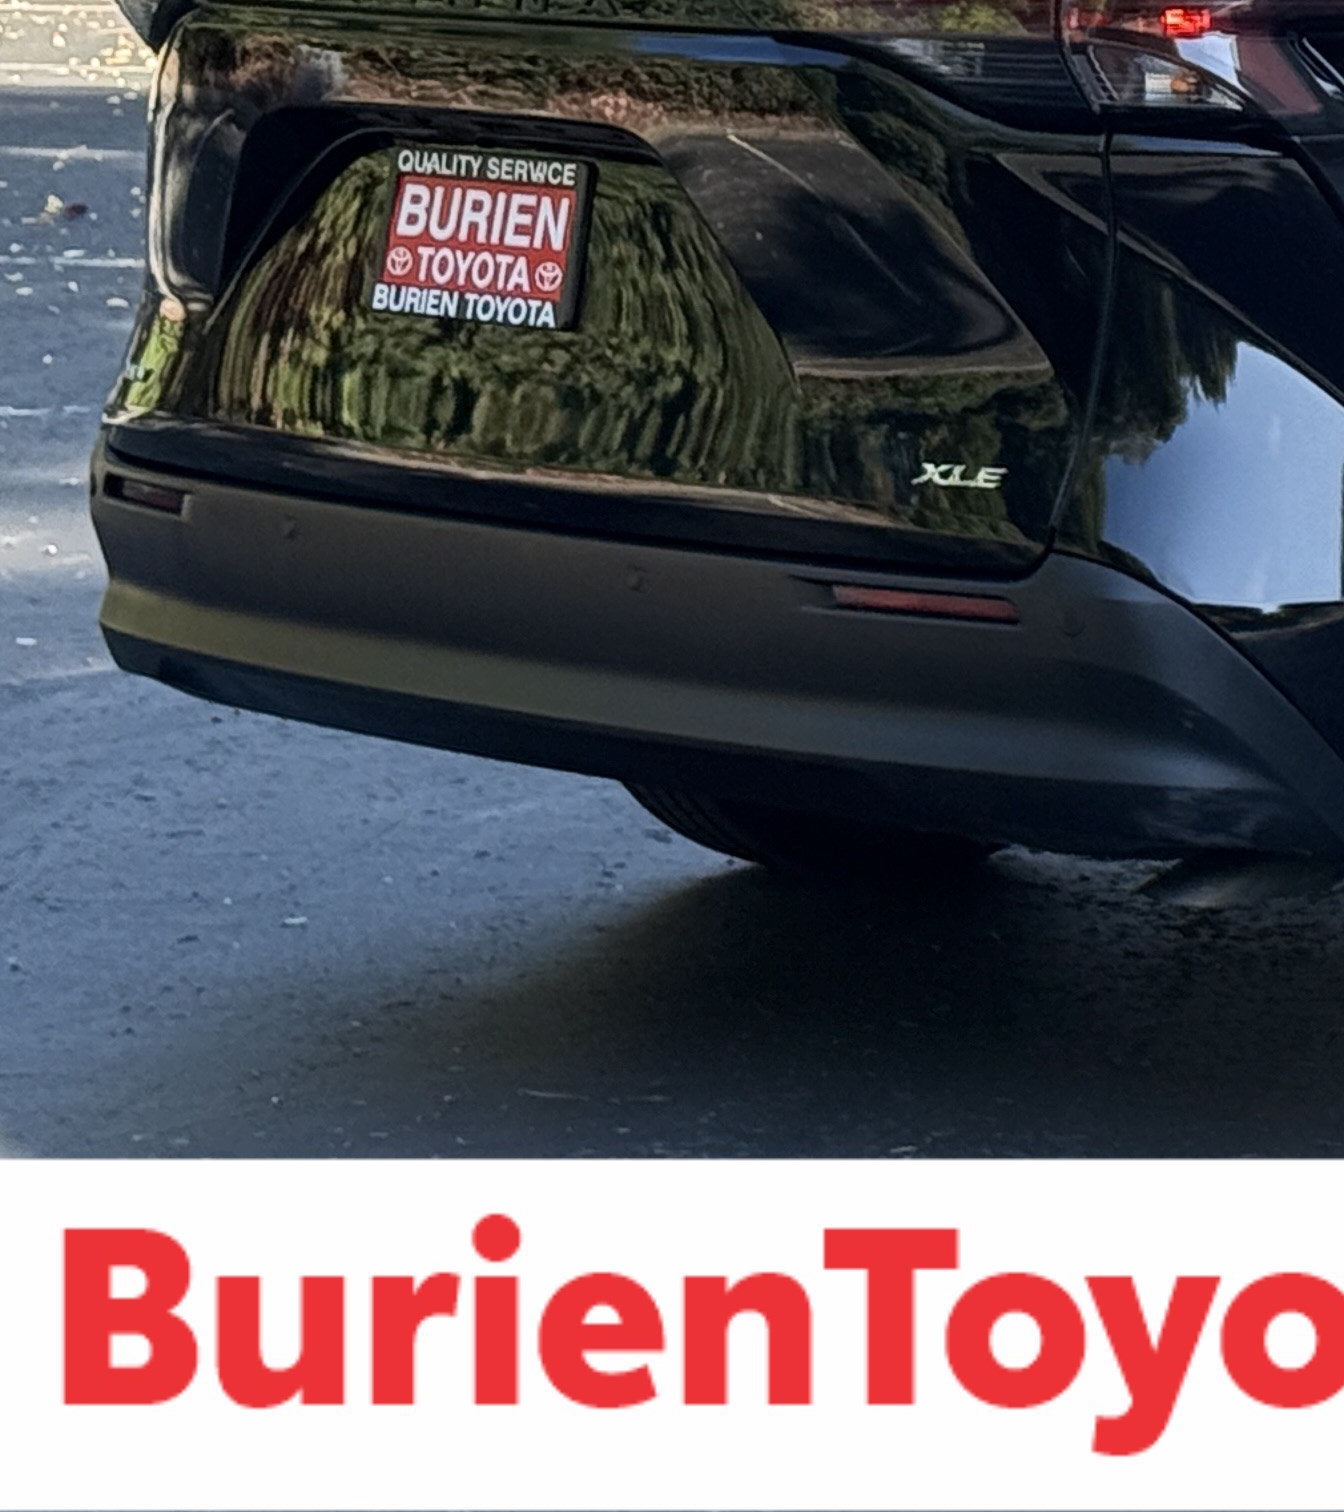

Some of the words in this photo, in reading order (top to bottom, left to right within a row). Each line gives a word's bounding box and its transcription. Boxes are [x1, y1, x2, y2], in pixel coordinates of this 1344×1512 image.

[398, 150, 483, 177] QUALITY
[396, 183, 570, 252] BURIEN
[417, 246, 531, 292] TOYOTA
[372, 283, 459, 317] BURIEN
[464, 292, 556, 328] TOYOTA
[910, 461, 1009, 489] XLE
